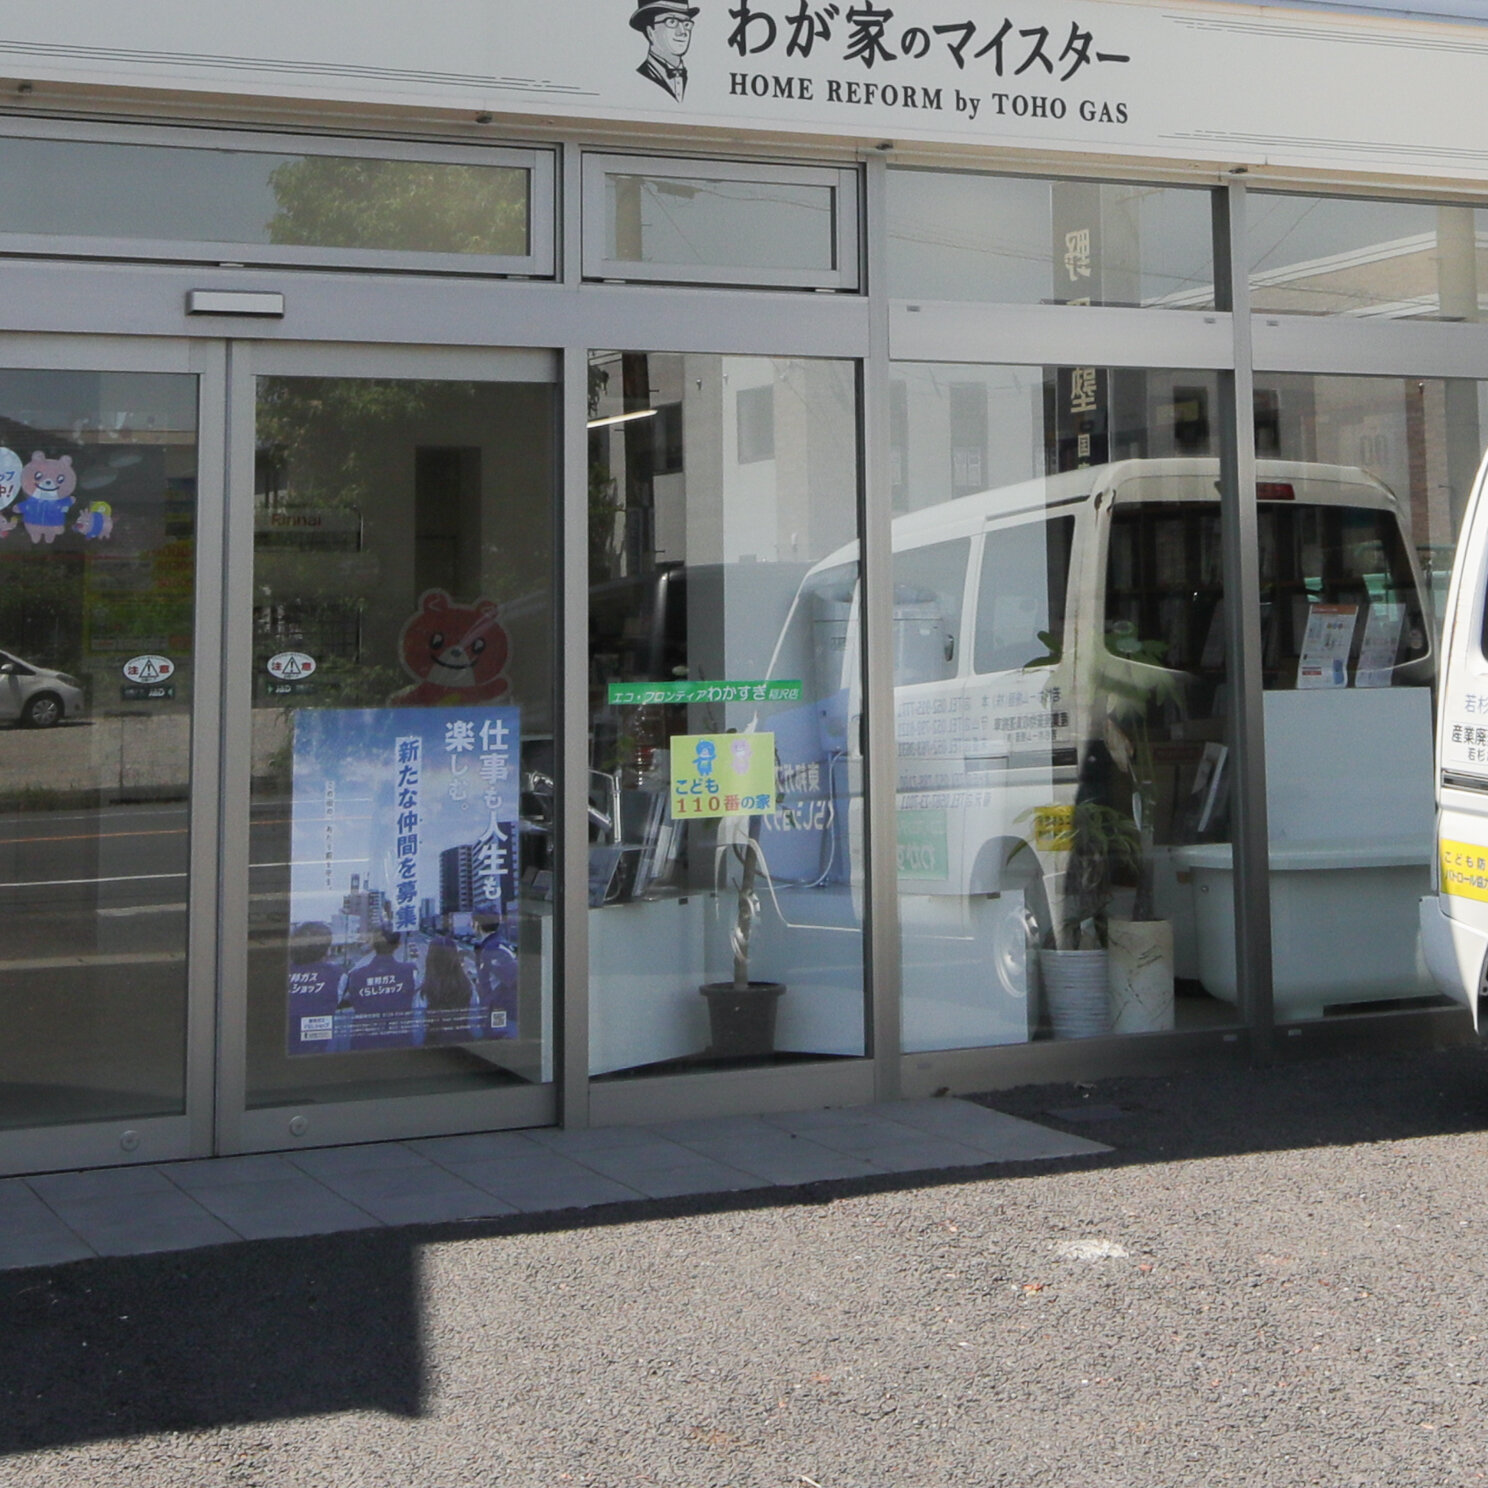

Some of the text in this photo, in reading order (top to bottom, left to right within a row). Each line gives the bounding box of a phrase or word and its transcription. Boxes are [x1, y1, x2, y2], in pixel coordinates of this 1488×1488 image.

[729, 72, 1129, 125] HOME REFORM by TOHO GAS
[444, 719, 475, 811] 楽しむ。
[675, 778, 720, 795] こども
[395, 739, 419, 931] 新たな仲間を募集
[478, 719, 509, 900] 仕事も人生も
[676, 794, 771, 813] 110番の家
